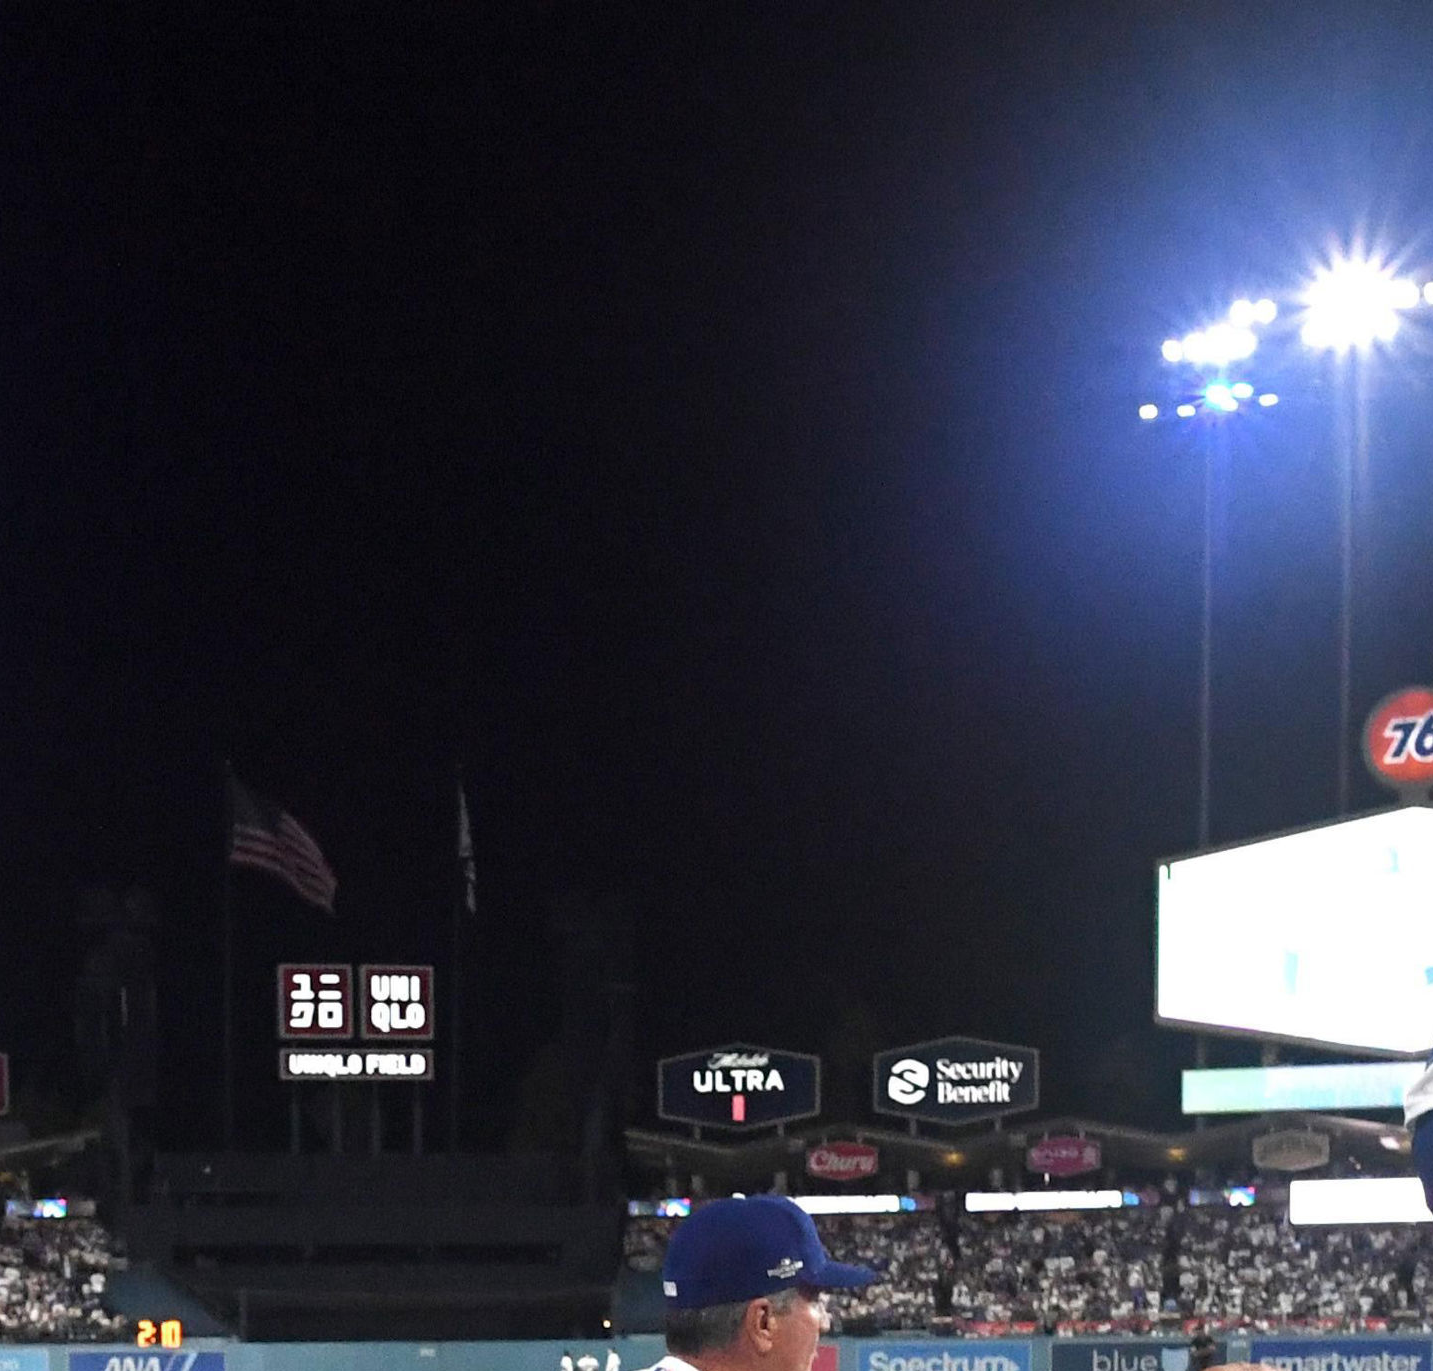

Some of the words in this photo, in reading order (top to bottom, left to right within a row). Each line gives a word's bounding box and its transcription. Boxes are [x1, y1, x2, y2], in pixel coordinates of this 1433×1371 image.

[371, 975, 421, 1002] UNI
[371, 1002, 426, 1032] QLO
[289, 1053, 363, 1077] UNIQLO
[365, 1053, 426, 1076] FIELD
[935, 1057, 1024, 1084] Security
[693, 1069, 785, 1093] ULTRA
[936, 1081, 1012, 1104] Benefit
